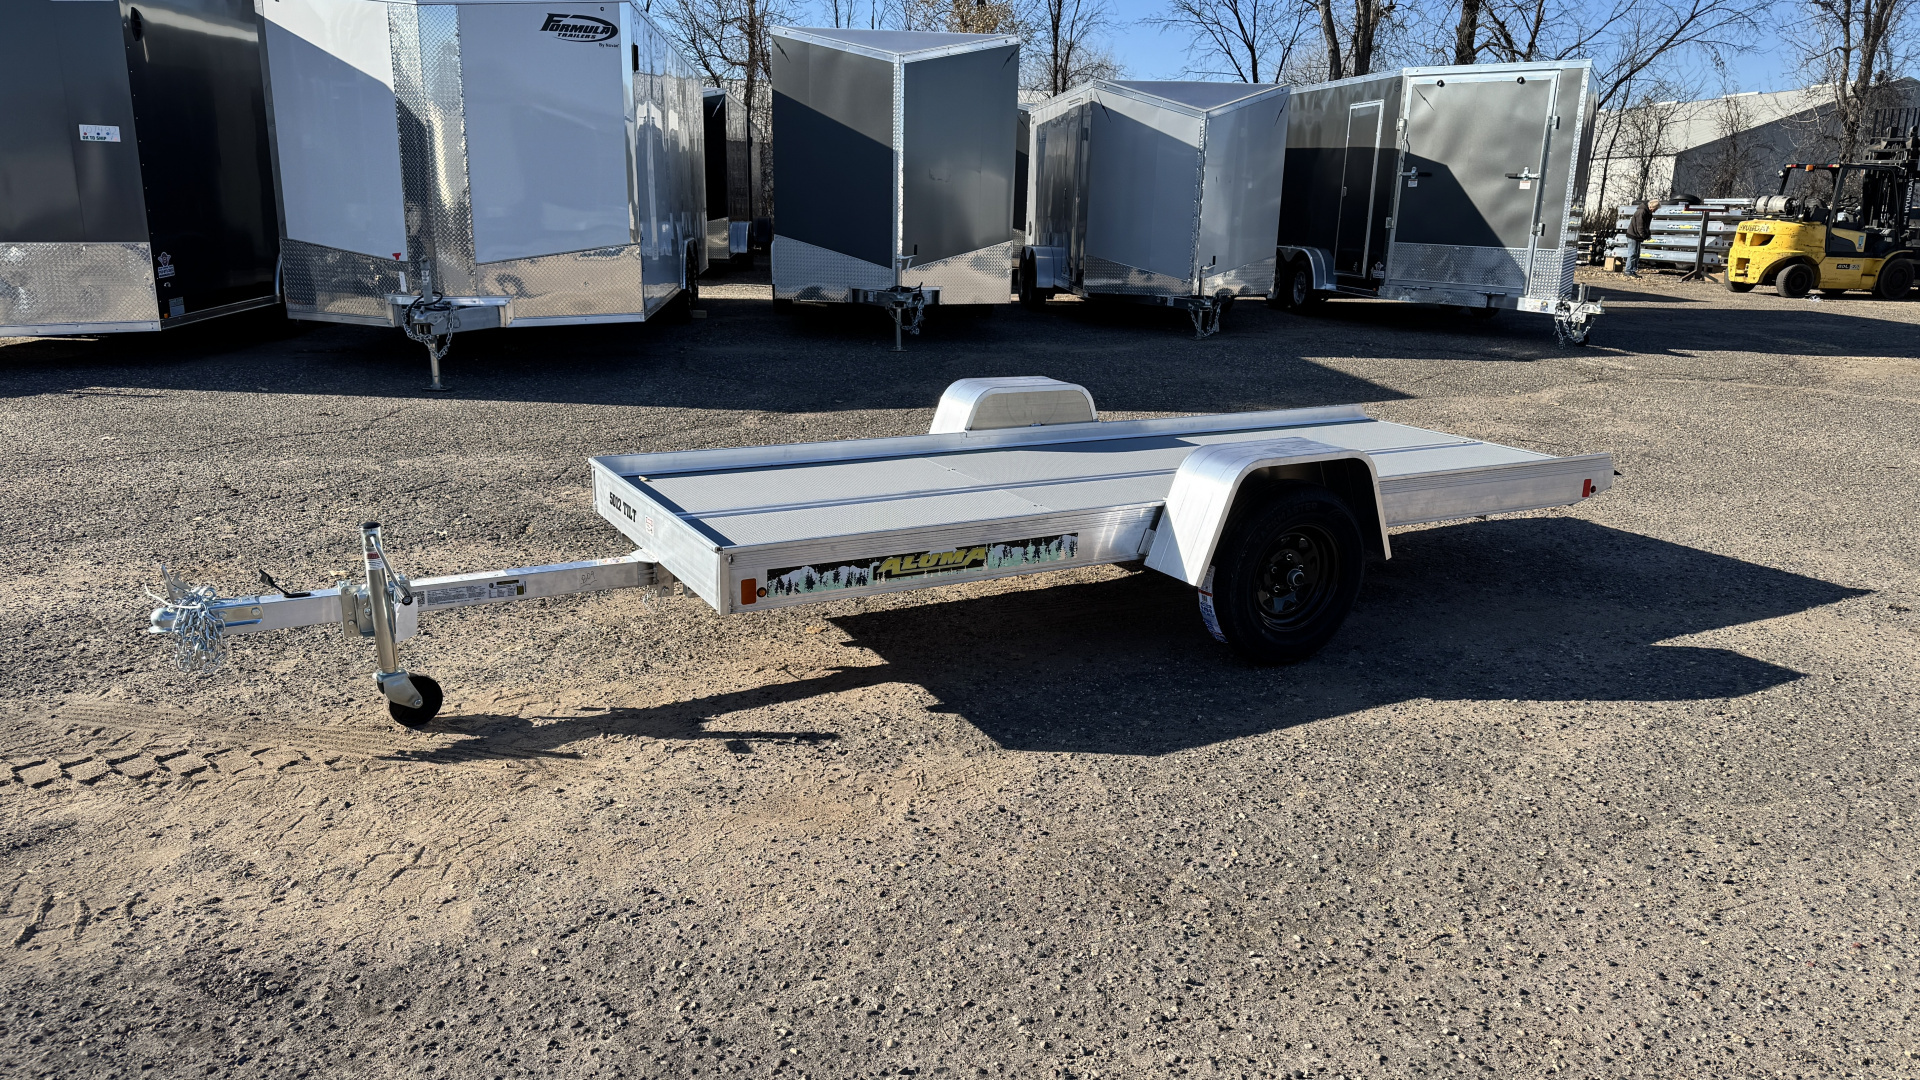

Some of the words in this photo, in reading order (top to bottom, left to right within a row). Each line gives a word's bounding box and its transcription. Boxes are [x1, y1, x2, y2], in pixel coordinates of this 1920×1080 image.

[539, 12, 612, 34] FORMULA
[1903, 178, 1915, 213] HYUNDAI
[622, 501, 637, 523] TILT
[876, 547, 986, 575] ALUMA
